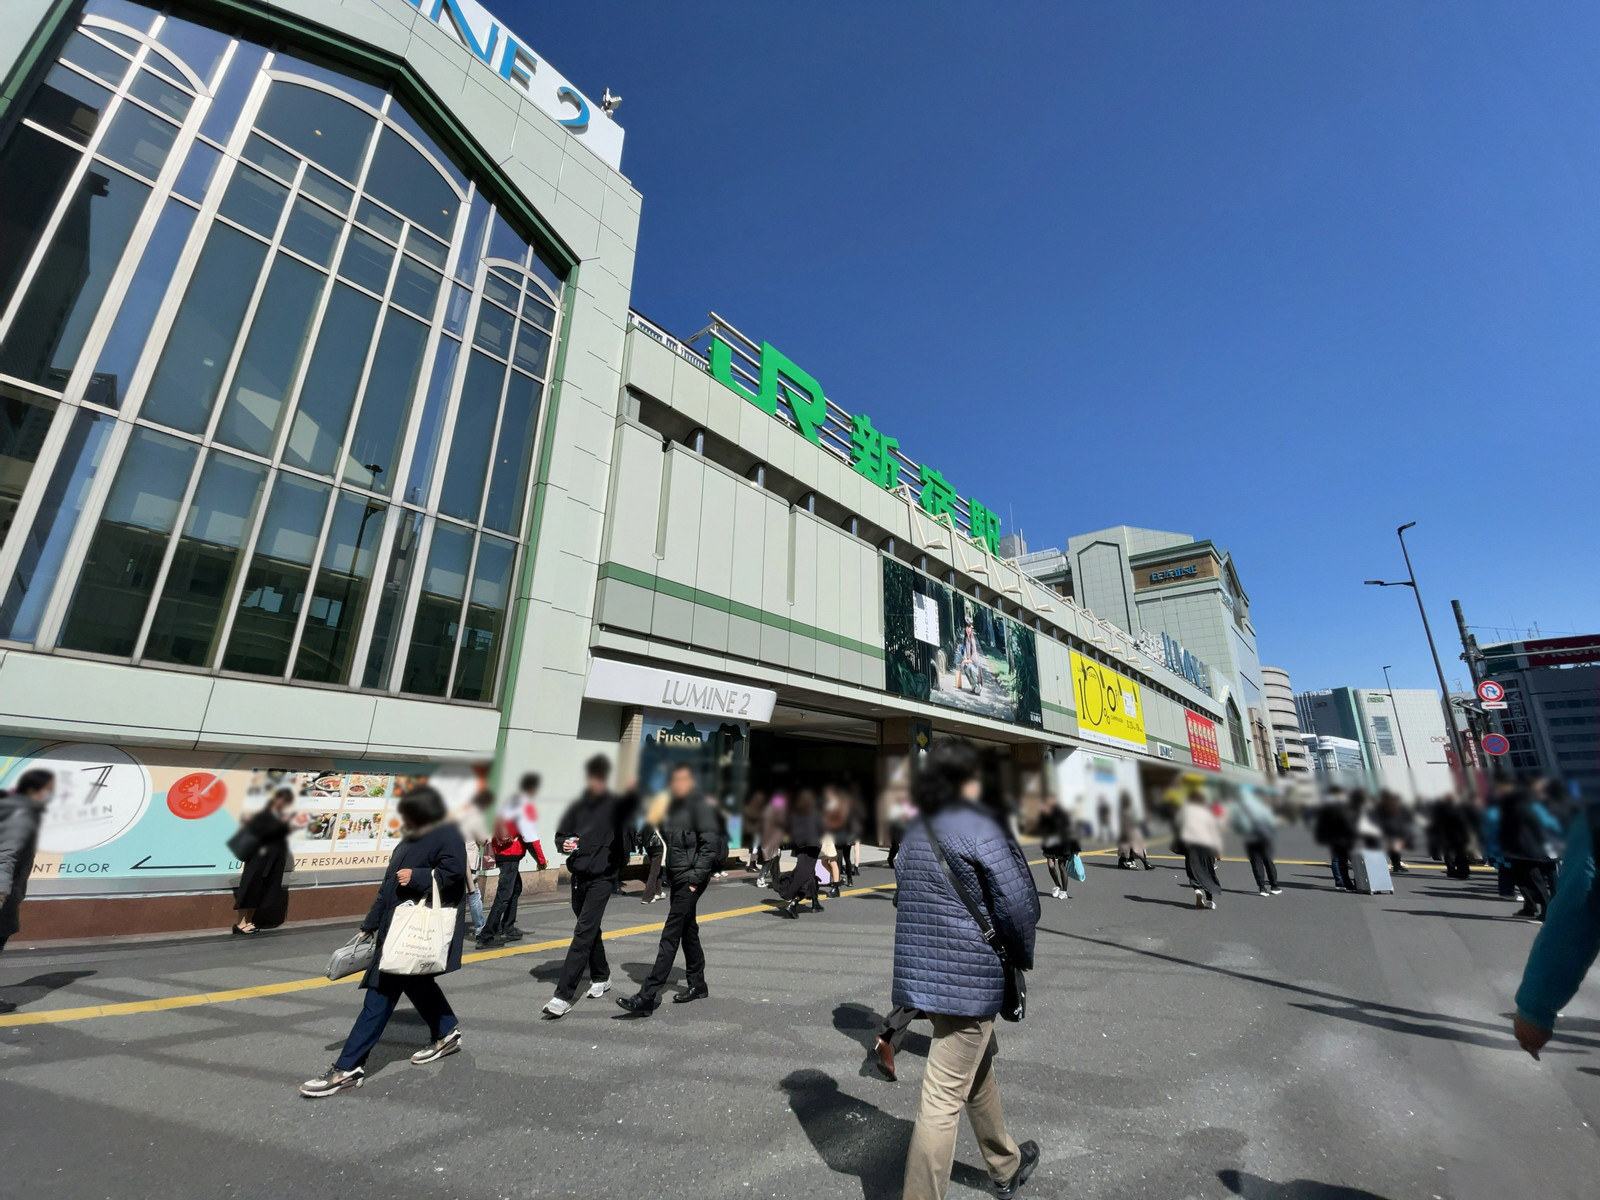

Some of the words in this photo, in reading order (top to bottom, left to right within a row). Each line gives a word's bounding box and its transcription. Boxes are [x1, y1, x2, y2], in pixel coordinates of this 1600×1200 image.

[402, 0, 537, 86] NE
[557, 86, 590, 130] 2
[709, 338, 826, 447] JR
[850, 414, 1001, 558] 新宿駅
[662, 679, 738, 714] LUMINE
[738, 692, 751, 715] 2
[656, 729, 701, 745] Fusion
[58, 863, 110, 873] FLOOR
[312, 856, 381, 866] RESTAURANT
